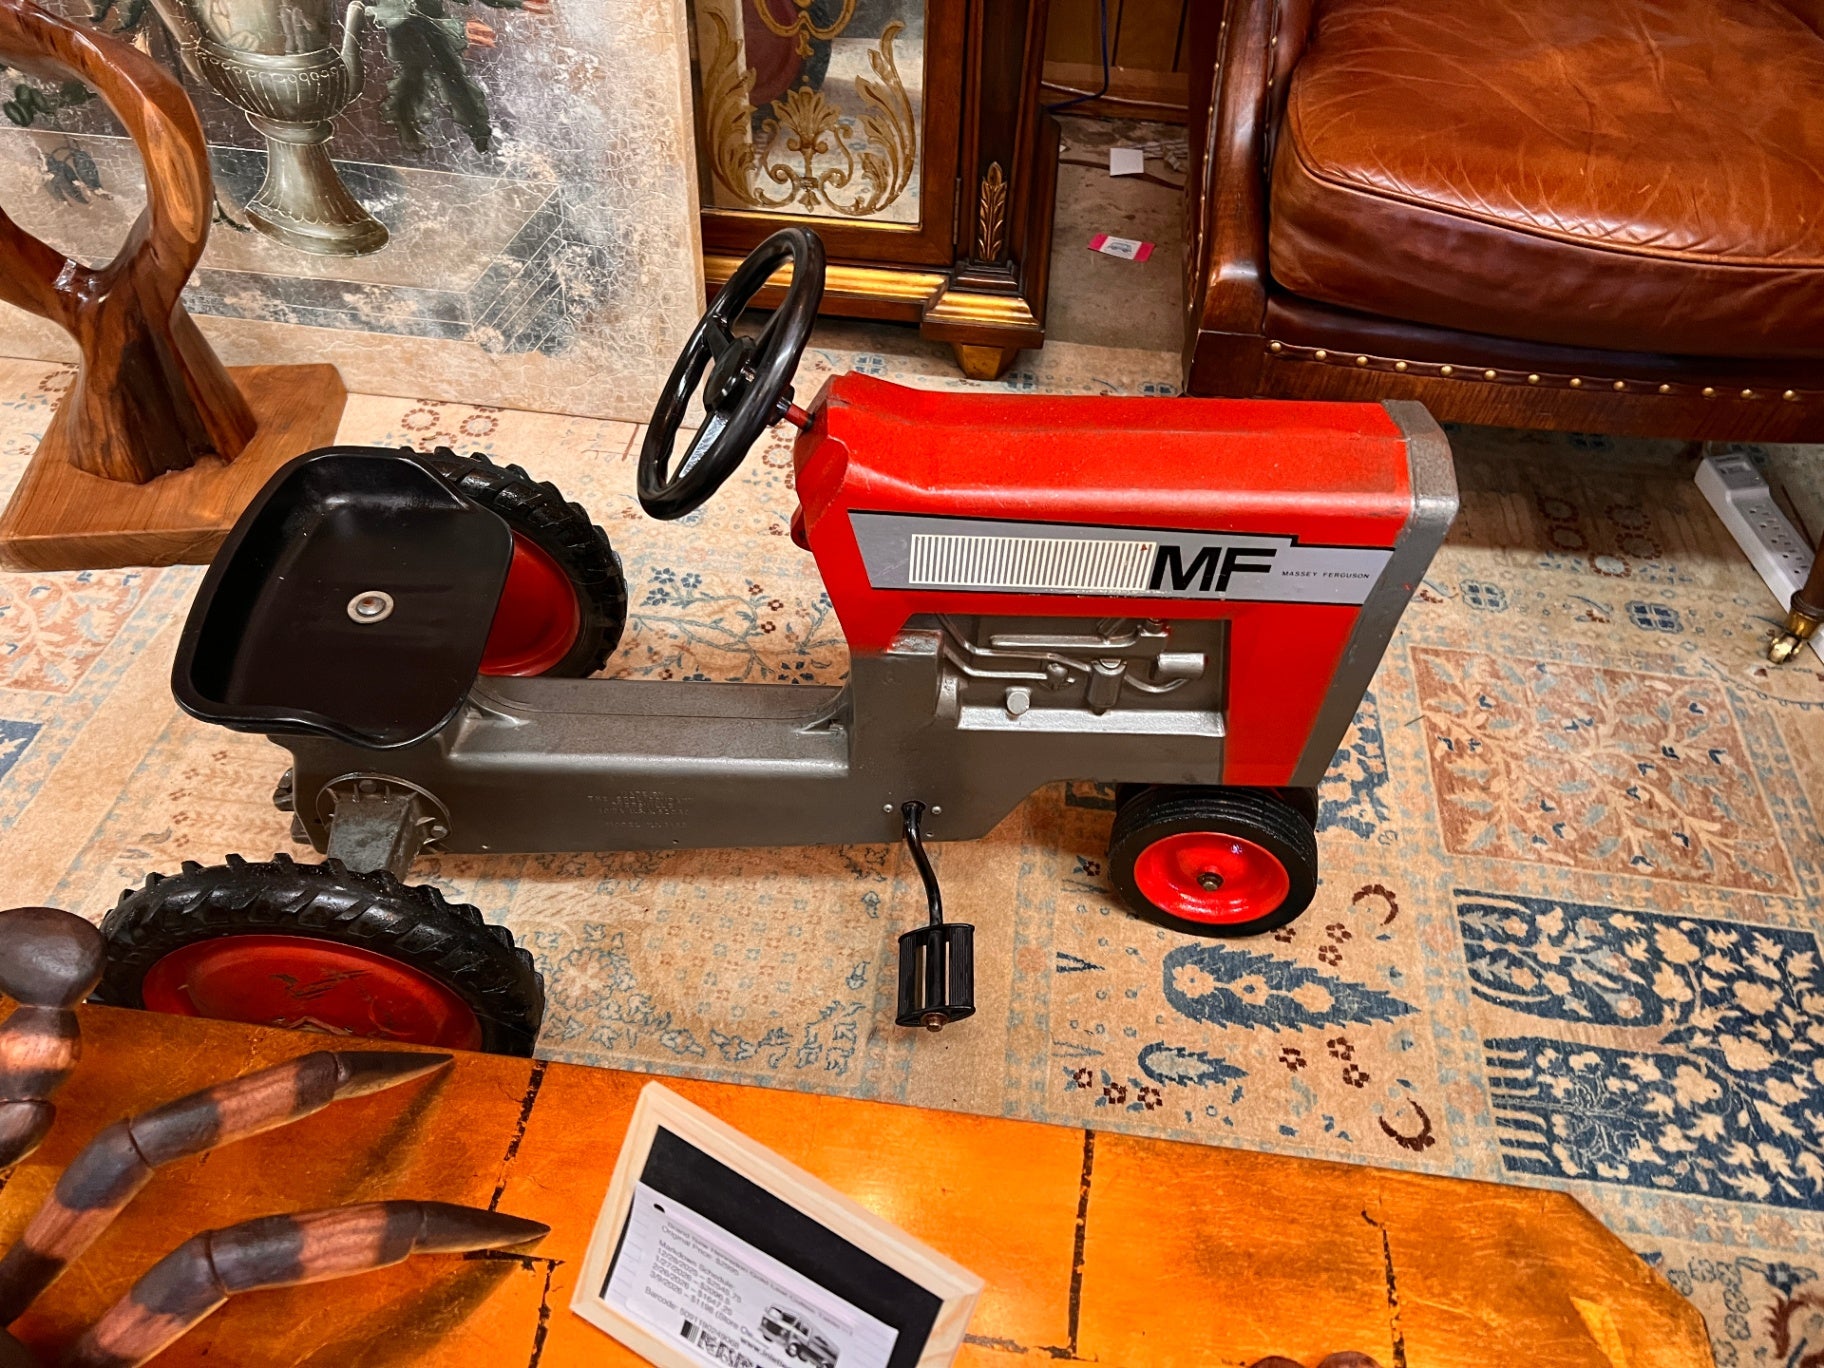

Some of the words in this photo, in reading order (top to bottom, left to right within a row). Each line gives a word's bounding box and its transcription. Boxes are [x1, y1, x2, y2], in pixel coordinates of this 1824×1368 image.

[1149, 545, 1277, 592] MF
[1281, 570, 1318, 578] MASSEY
[662, 1225, 691, 1247] Original
[659, 1239, 698, 1267] Markdown
